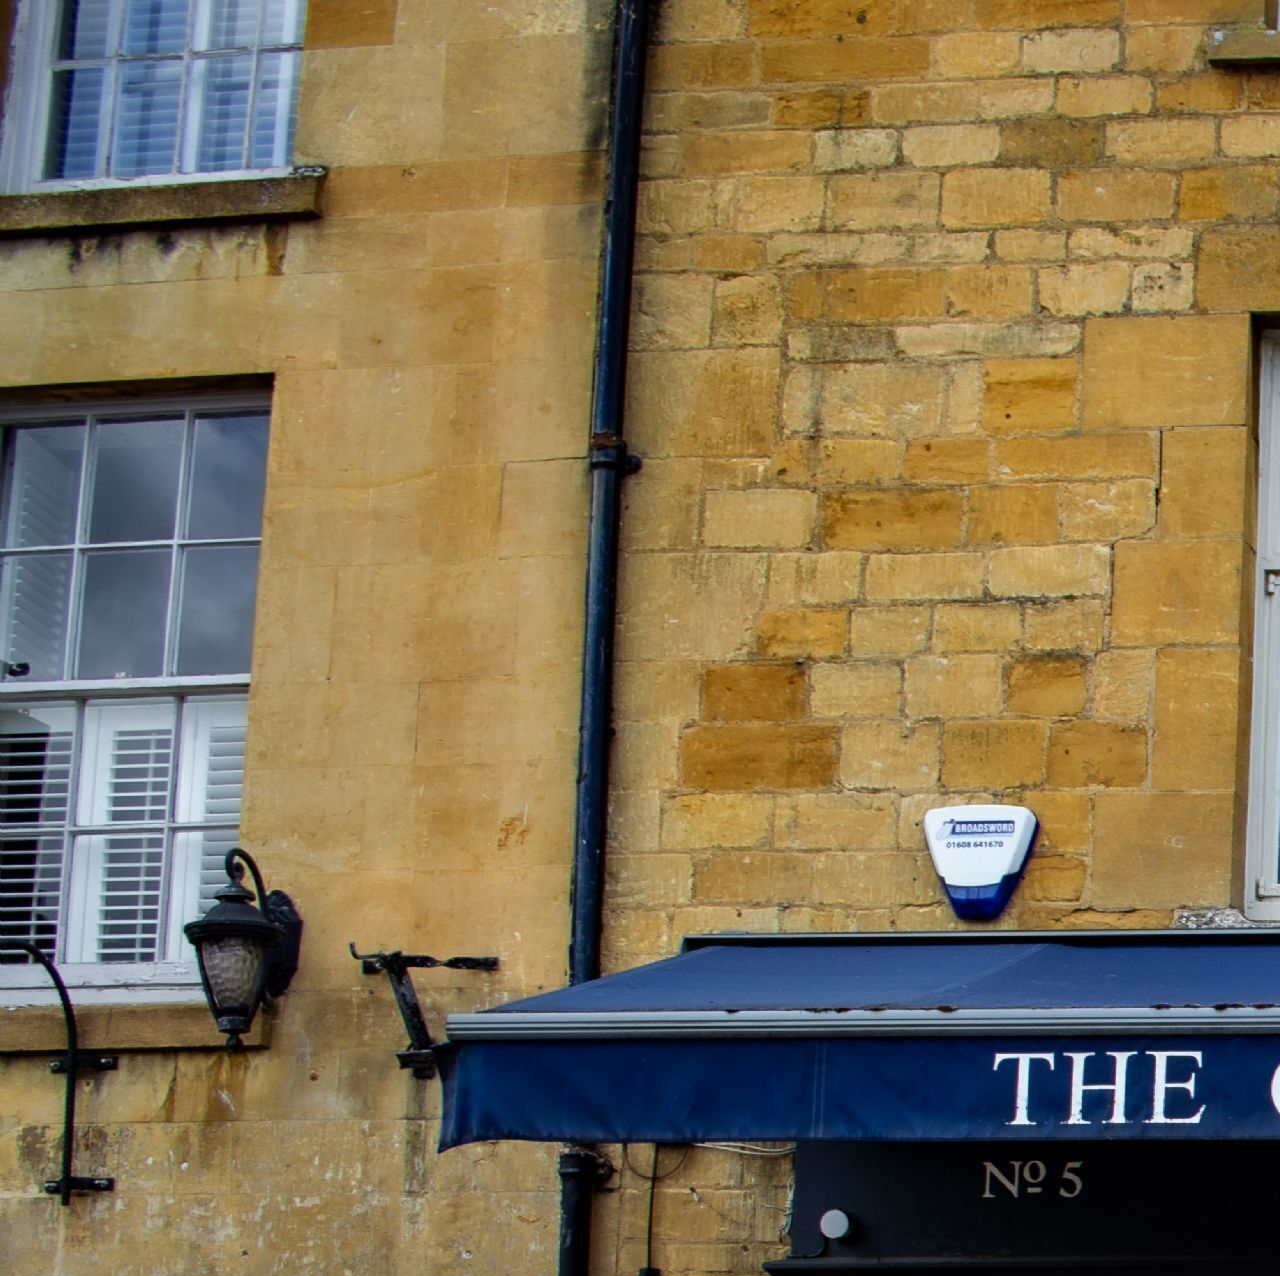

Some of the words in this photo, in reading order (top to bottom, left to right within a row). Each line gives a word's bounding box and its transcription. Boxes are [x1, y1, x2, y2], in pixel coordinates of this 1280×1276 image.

[955, 823, 1014, 833] BROADSWORD
[994, 1052, 1206, 1126] THE
[1060, 1161, 1083, 1198] 5
